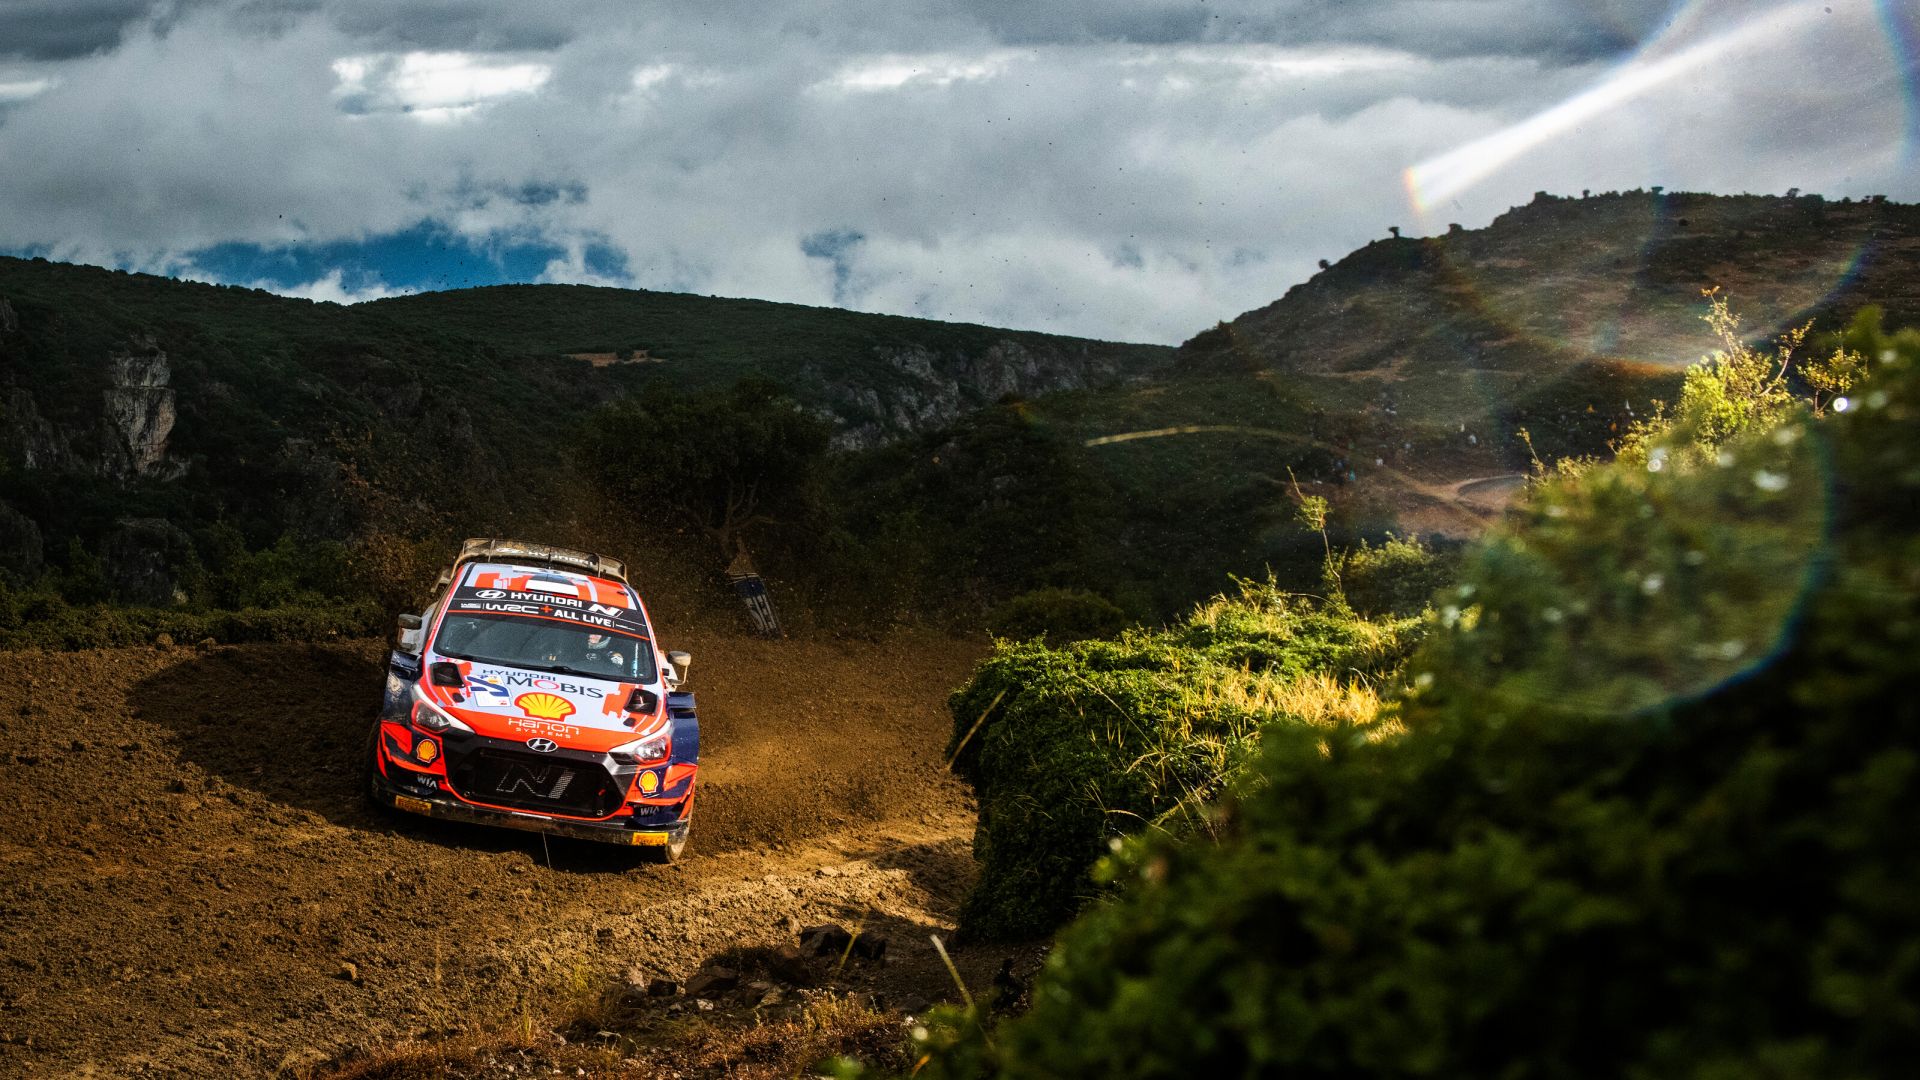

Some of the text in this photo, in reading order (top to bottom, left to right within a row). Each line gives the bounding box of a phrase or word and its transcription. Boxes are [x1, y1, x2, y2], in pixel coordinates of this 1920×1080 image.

[511, 592, 624, 618] HYUNDAI N
[486, 602, 539, 614] WRC
[553, 609, 579, 620] ALL
[582, 614, 612, 627] LIVE
[482, 669, 557, 682] HYUNDAI
[506, 676, 604, 699] MOBIS
[515, 727, 571, 739] SYSTEMS
[416, 774, 438, 790] WIA
[640, 805, 660, 816] WIA
